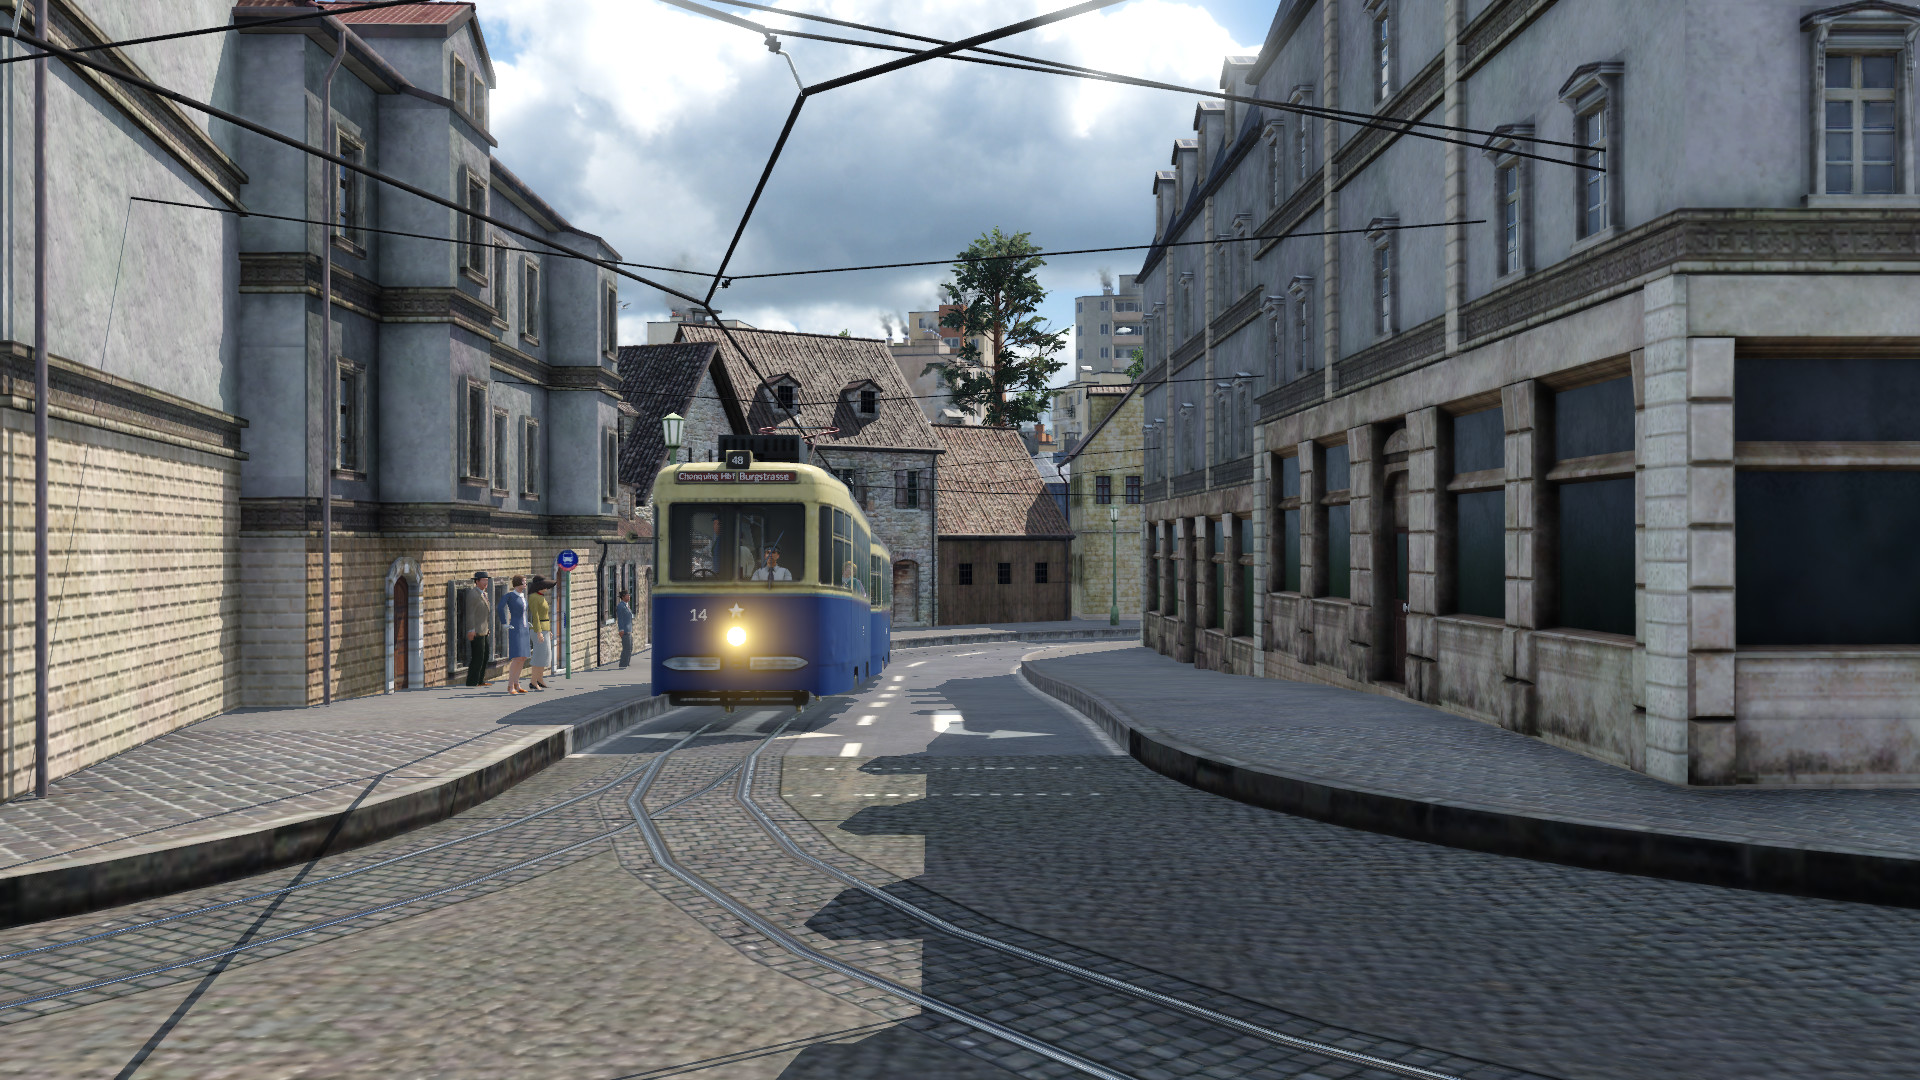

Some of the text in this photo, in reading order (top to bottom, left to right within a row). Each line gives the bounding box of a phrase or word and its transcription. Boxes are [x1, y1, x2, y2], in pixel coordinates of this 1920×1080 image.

[731, 455, 744, 465] 48
[739, 472, 790, 483] Burgstrasse
[689, 608, 708, 622] 14
